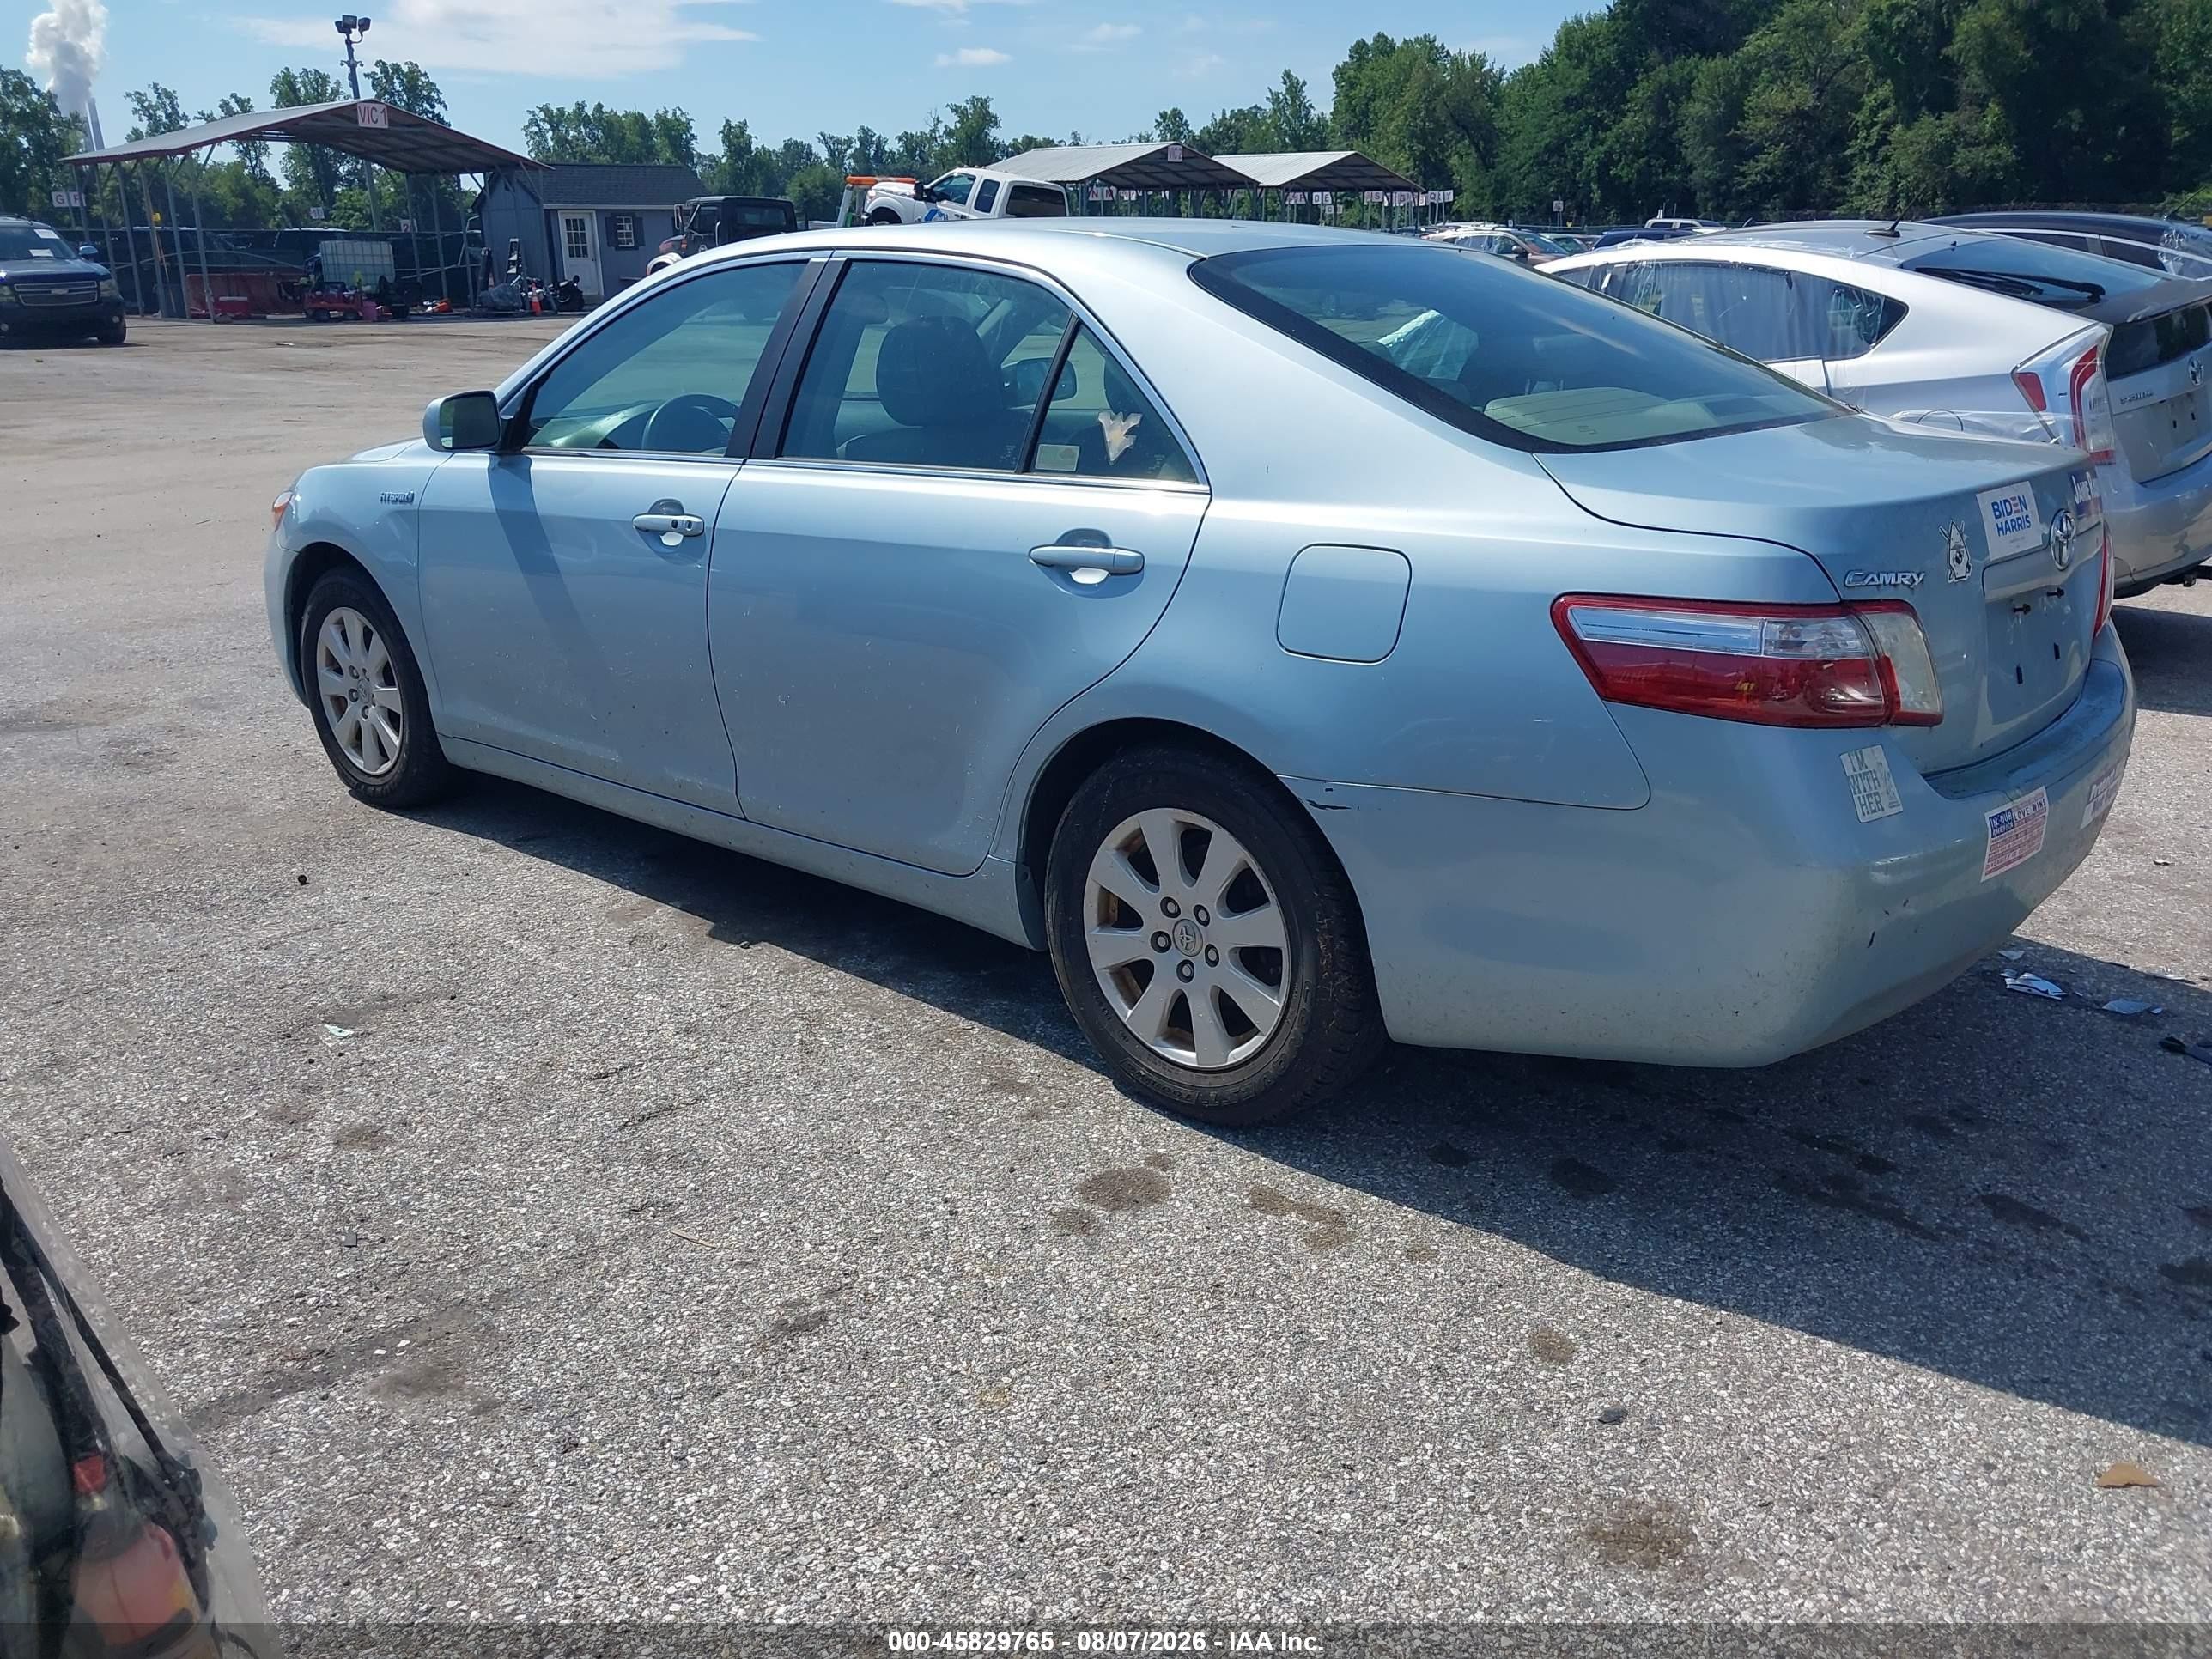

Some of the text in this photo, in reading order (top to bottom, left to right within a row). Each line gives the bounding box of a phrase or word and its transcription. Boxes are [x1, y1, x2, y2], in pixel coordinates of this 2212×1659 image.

[358, 106, 386, 125] VIC 1
[56, 194, 64, 204] G
[1991, 494, 2028, 520] BIDEN
[1996, 514, 2032, 537] HARRIS
[1844, 569, 1925, 588] CAMRY
[1857, 791, 1885, 817] HER
[2014, 798, 2046, 822] LOVE WINS
